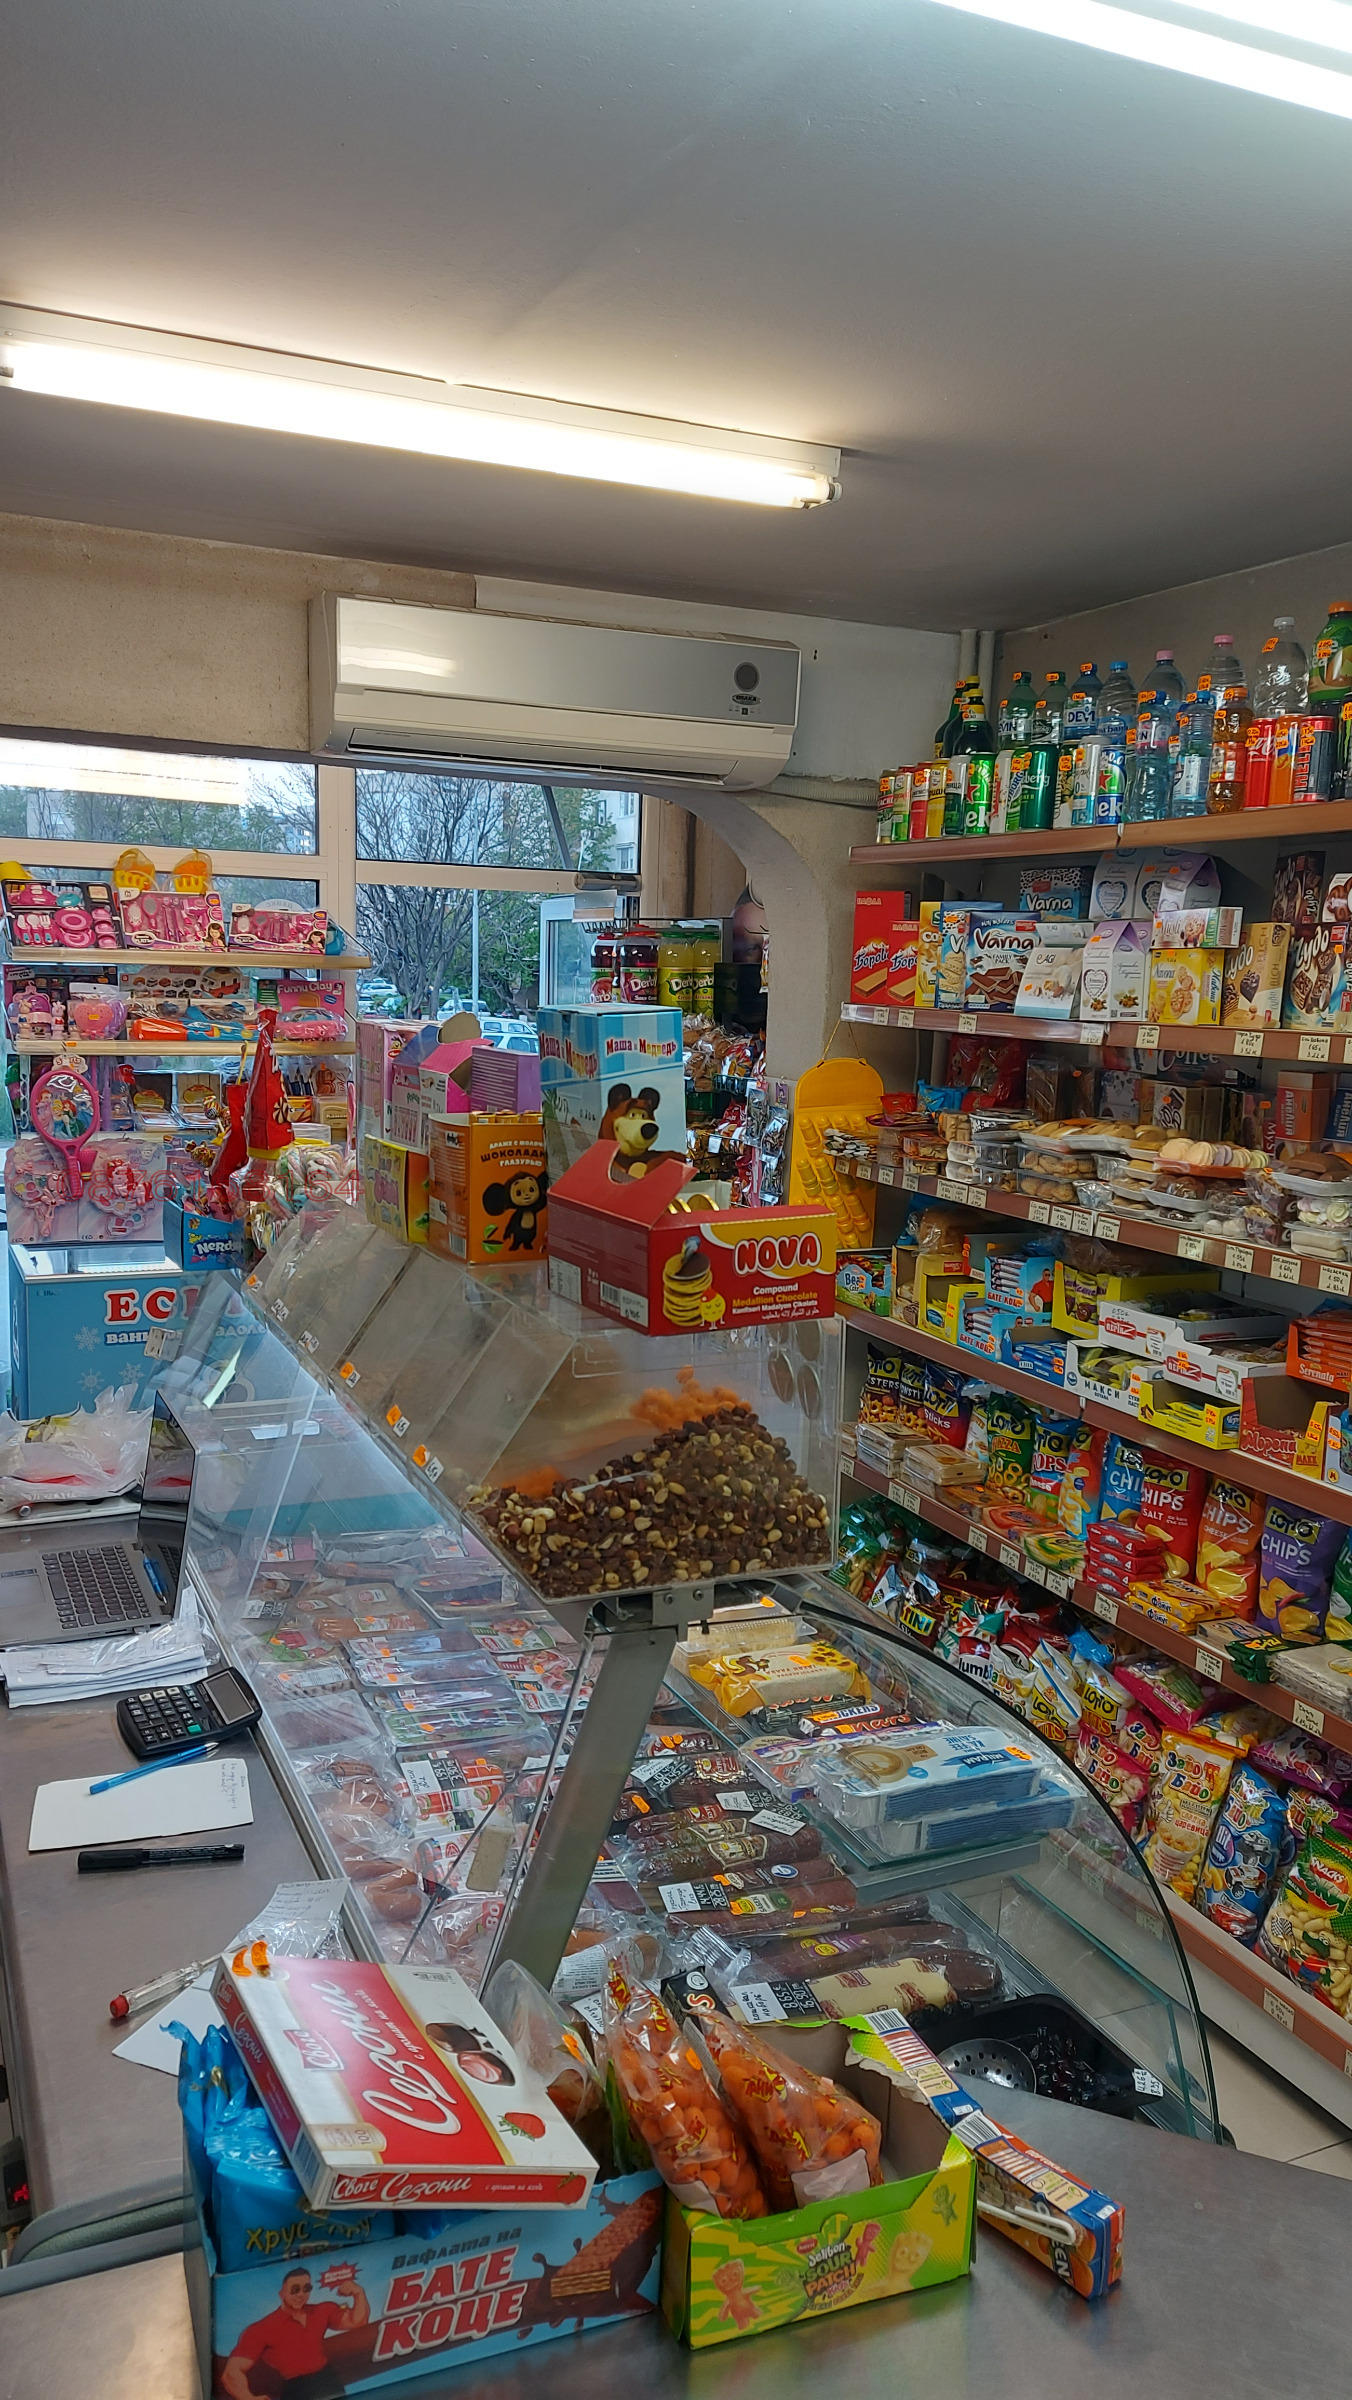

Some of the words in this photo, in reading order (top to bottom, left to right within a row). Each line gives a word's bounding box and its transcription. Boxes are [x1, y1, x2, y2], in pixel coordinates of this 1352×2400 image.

[1027, 894, 1073, 911] Varna
[974, 928, 1034, 951] Varna
[277, 984, 308, 994] Funny
[309, 982, 333, 994] Clay
[606, 1038, 632, 1056] Маша
[734, 1232, 822, 1275] NOVA
[732, 1297, 775, 1308] Medallion
[776, 1290, 818, 1303] Chocolate
[752, 1283, 799, 1295] Compound
[761, 1303, 792, 1313] Madalyon
[1299, 1363, 1334, 1384] Serenata
[1084, 1381, 1120, 1400] МАКСИ
[924, 1408, 951, 1429] Sticks
[991, 1436, 1022, 1454] PIZZA
[1142, 1508, 1164, 1521] SALT
[1202, 1501, 1250, 1534] CHIPS
[1260, 1533, 1312, 1566] CHIPS
[1166, 1750, 1203, 1779] Зайо
[1168, 1771, 1212, 1802] Байо
[1310, 1857, 1346, 1884] SNACKS
[310, 1979, 462, 2135] Сезони
[332, 2175, 379, 2201] Своге
[380, 2172, 473, 2206] Сезони
[391, 2234, 491, 2270] Вафлата
[495, 2226, 522, 2243] на
[804, 2260, 856, 2298] PATCH
[805, 2251, 853, 2281] SOUR
[382, 2244, 519, 2317] БАТЕ
[372, 2281, 528, 2363] КОЦЕ
